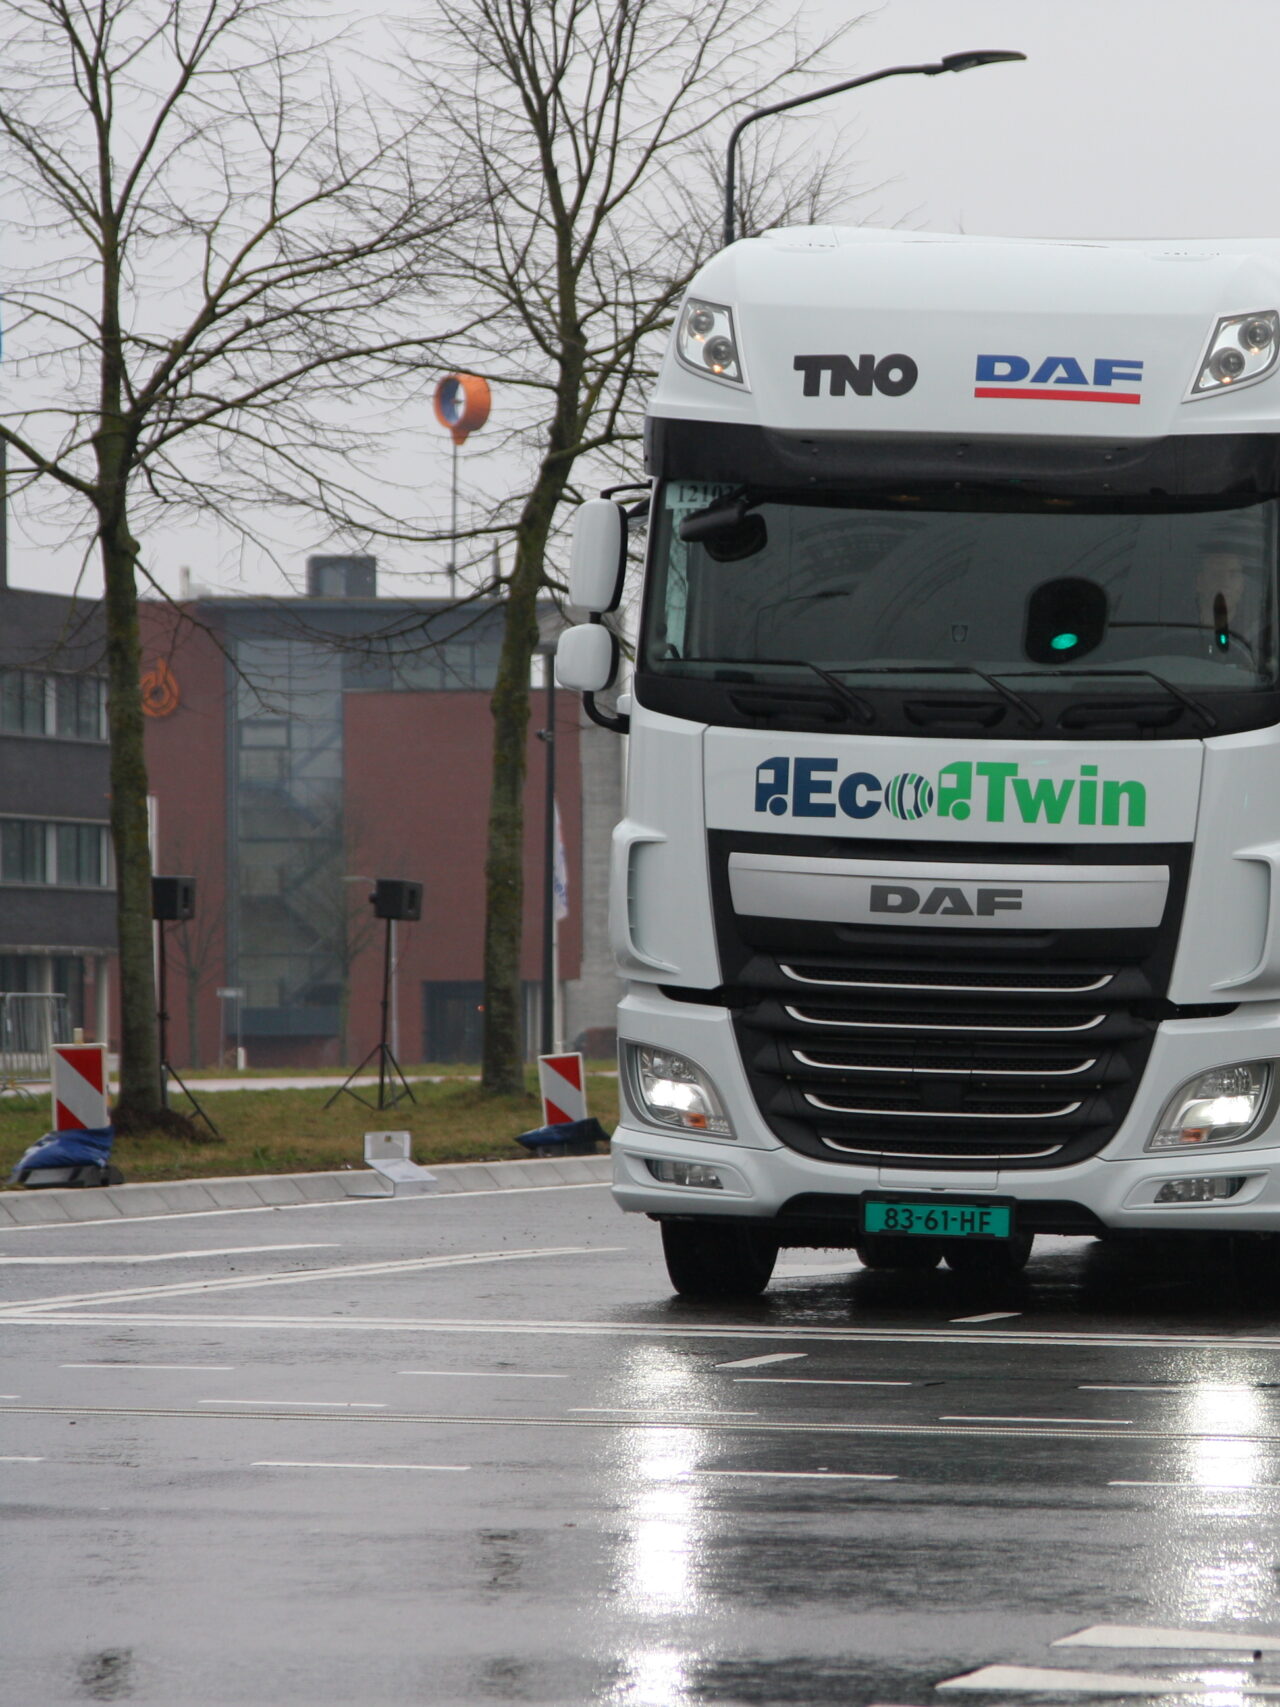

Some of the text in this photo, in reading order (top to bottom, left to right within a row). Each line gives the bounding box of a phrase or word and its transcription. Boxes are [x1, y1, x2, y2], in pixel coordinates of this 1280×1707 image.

[794, 354, 918, 396] TNO
[975, 354, 1144, 387] DAF
[870, 884, 1023, 916] DAF
[884, 1207, 992, 1232] 83-61-HF
